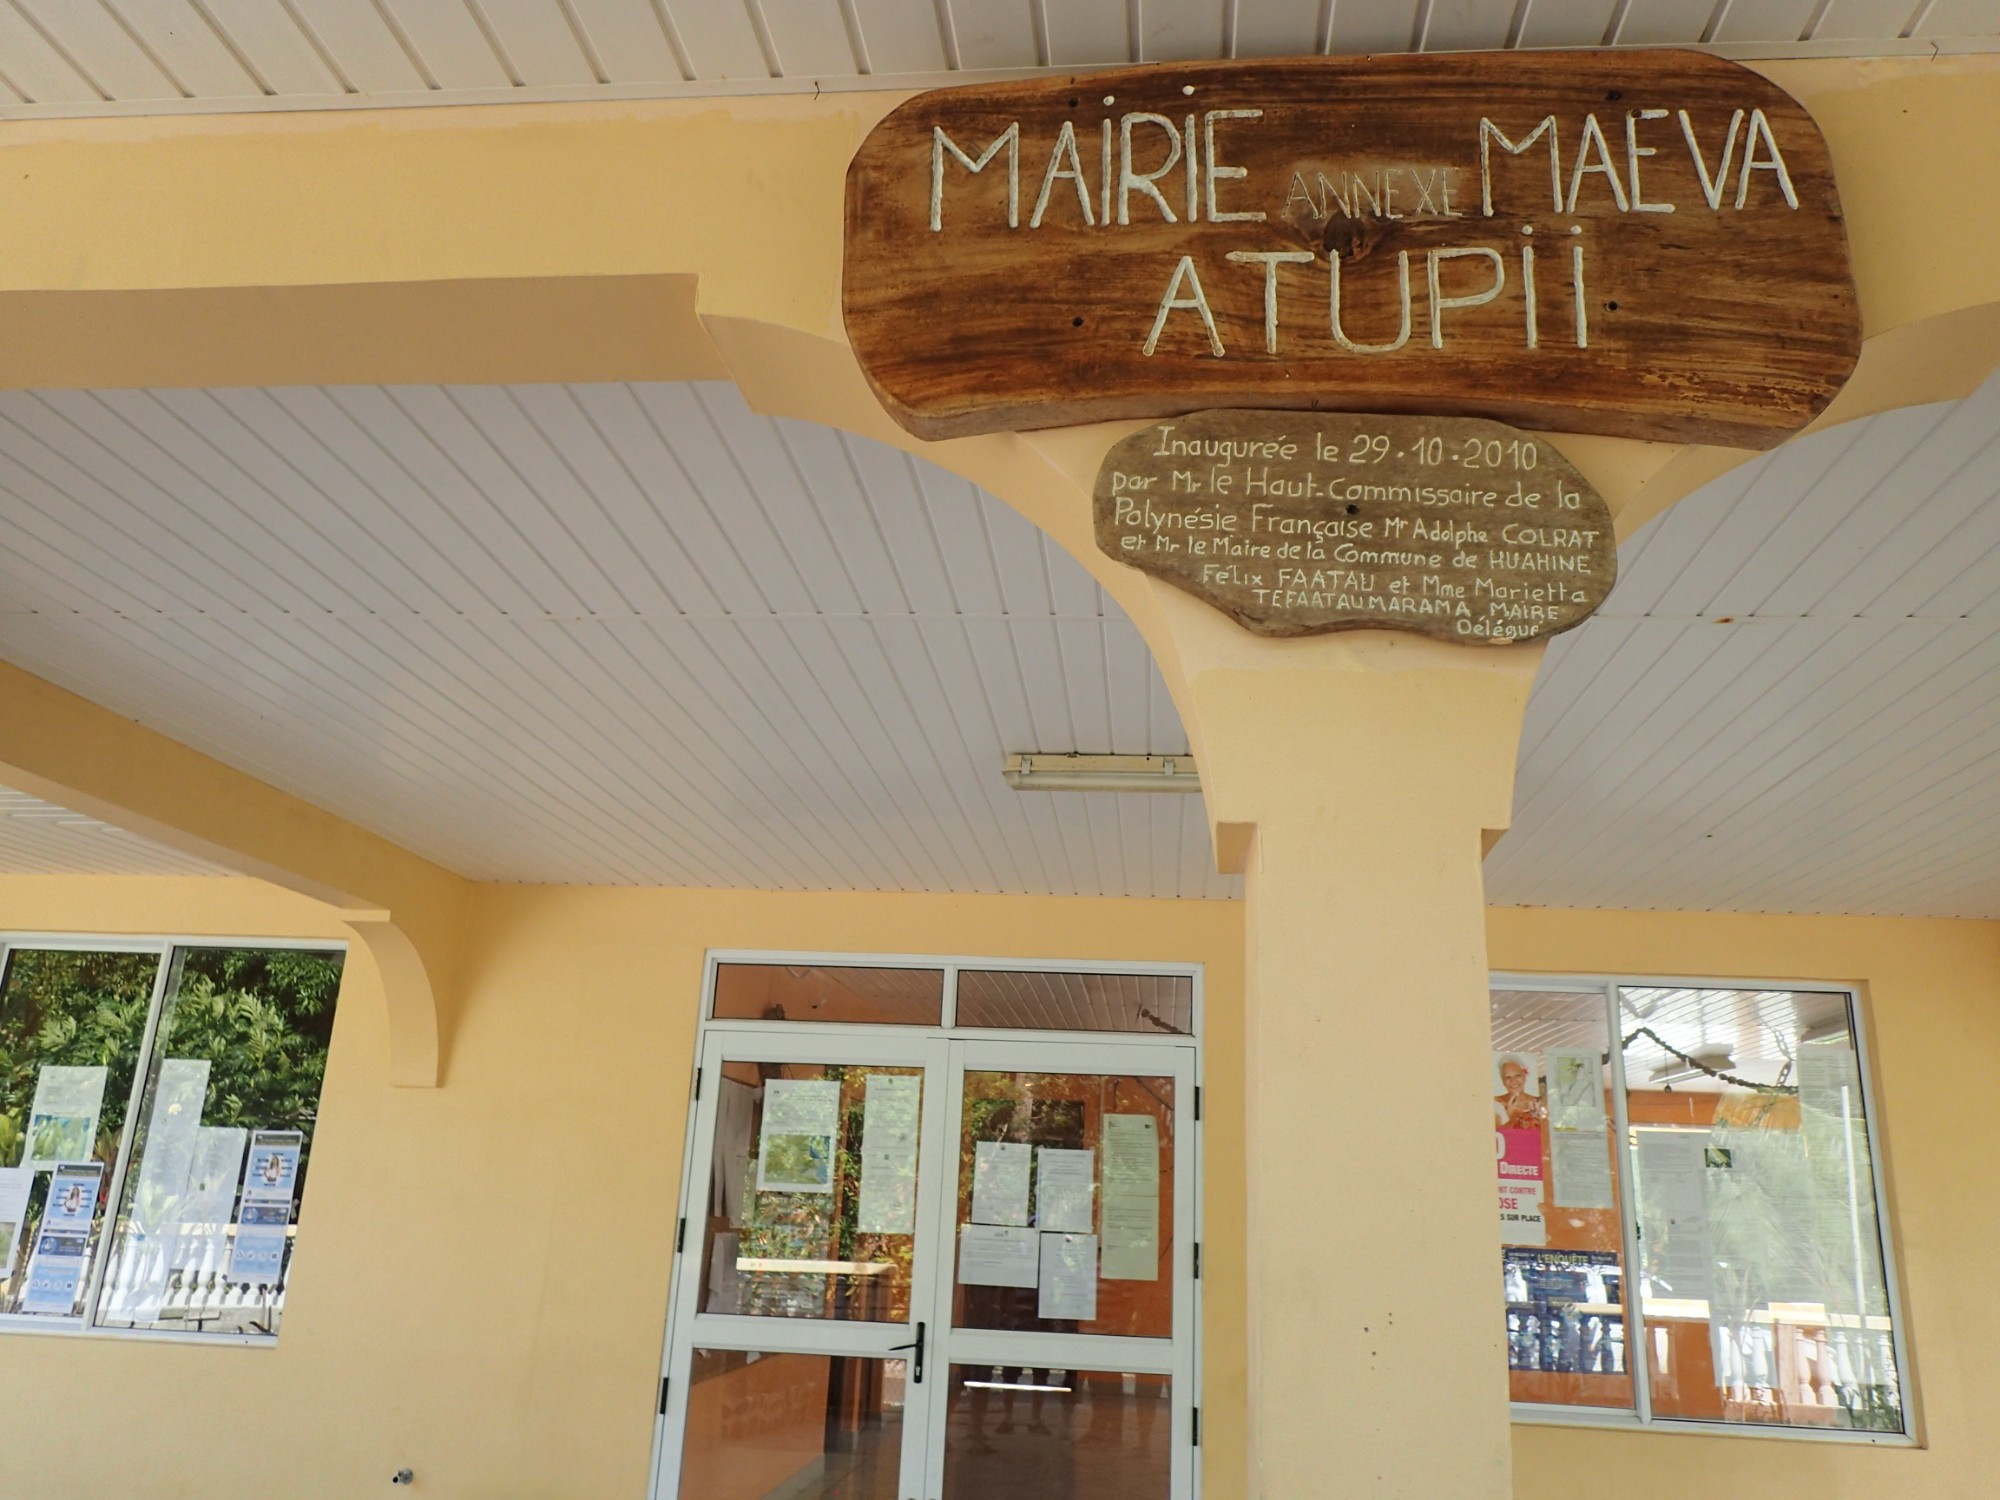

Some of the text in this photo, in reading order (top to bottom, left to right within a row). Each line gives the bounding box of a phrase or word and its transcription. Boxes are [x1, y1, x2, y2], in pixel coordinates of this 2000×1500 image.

[1281, 167, 1463, 220] ANNEXE
[1479, 108, 1799, 217] MAEVA
[1152, 425, 1298, 468] Inaugurée
[1316, 431, 1339, 462] le
[1111, 470, 1157, 496] par
[1171, 469, 1202, 494] Mr
[1210, 466, 1233, 495] le
[1504, 480, 1542, 509] de
[1557, 479, 1582, 510] la
[1114, 495, 1601, 550] Polynésie Française Mr Adolphe COLRAT
[1120, 533, 1592, 575] et Mr le Maire de la Commune de HUAHINE
[1278, 567, 1376, 593] FAATAU
[1388, 575, 1411, 596] et
[1422, 574, 1466, 600] Mme
[1474, 577, 1589, 603] Marietta
[1489, 600, 1560, 622] MAIRE
